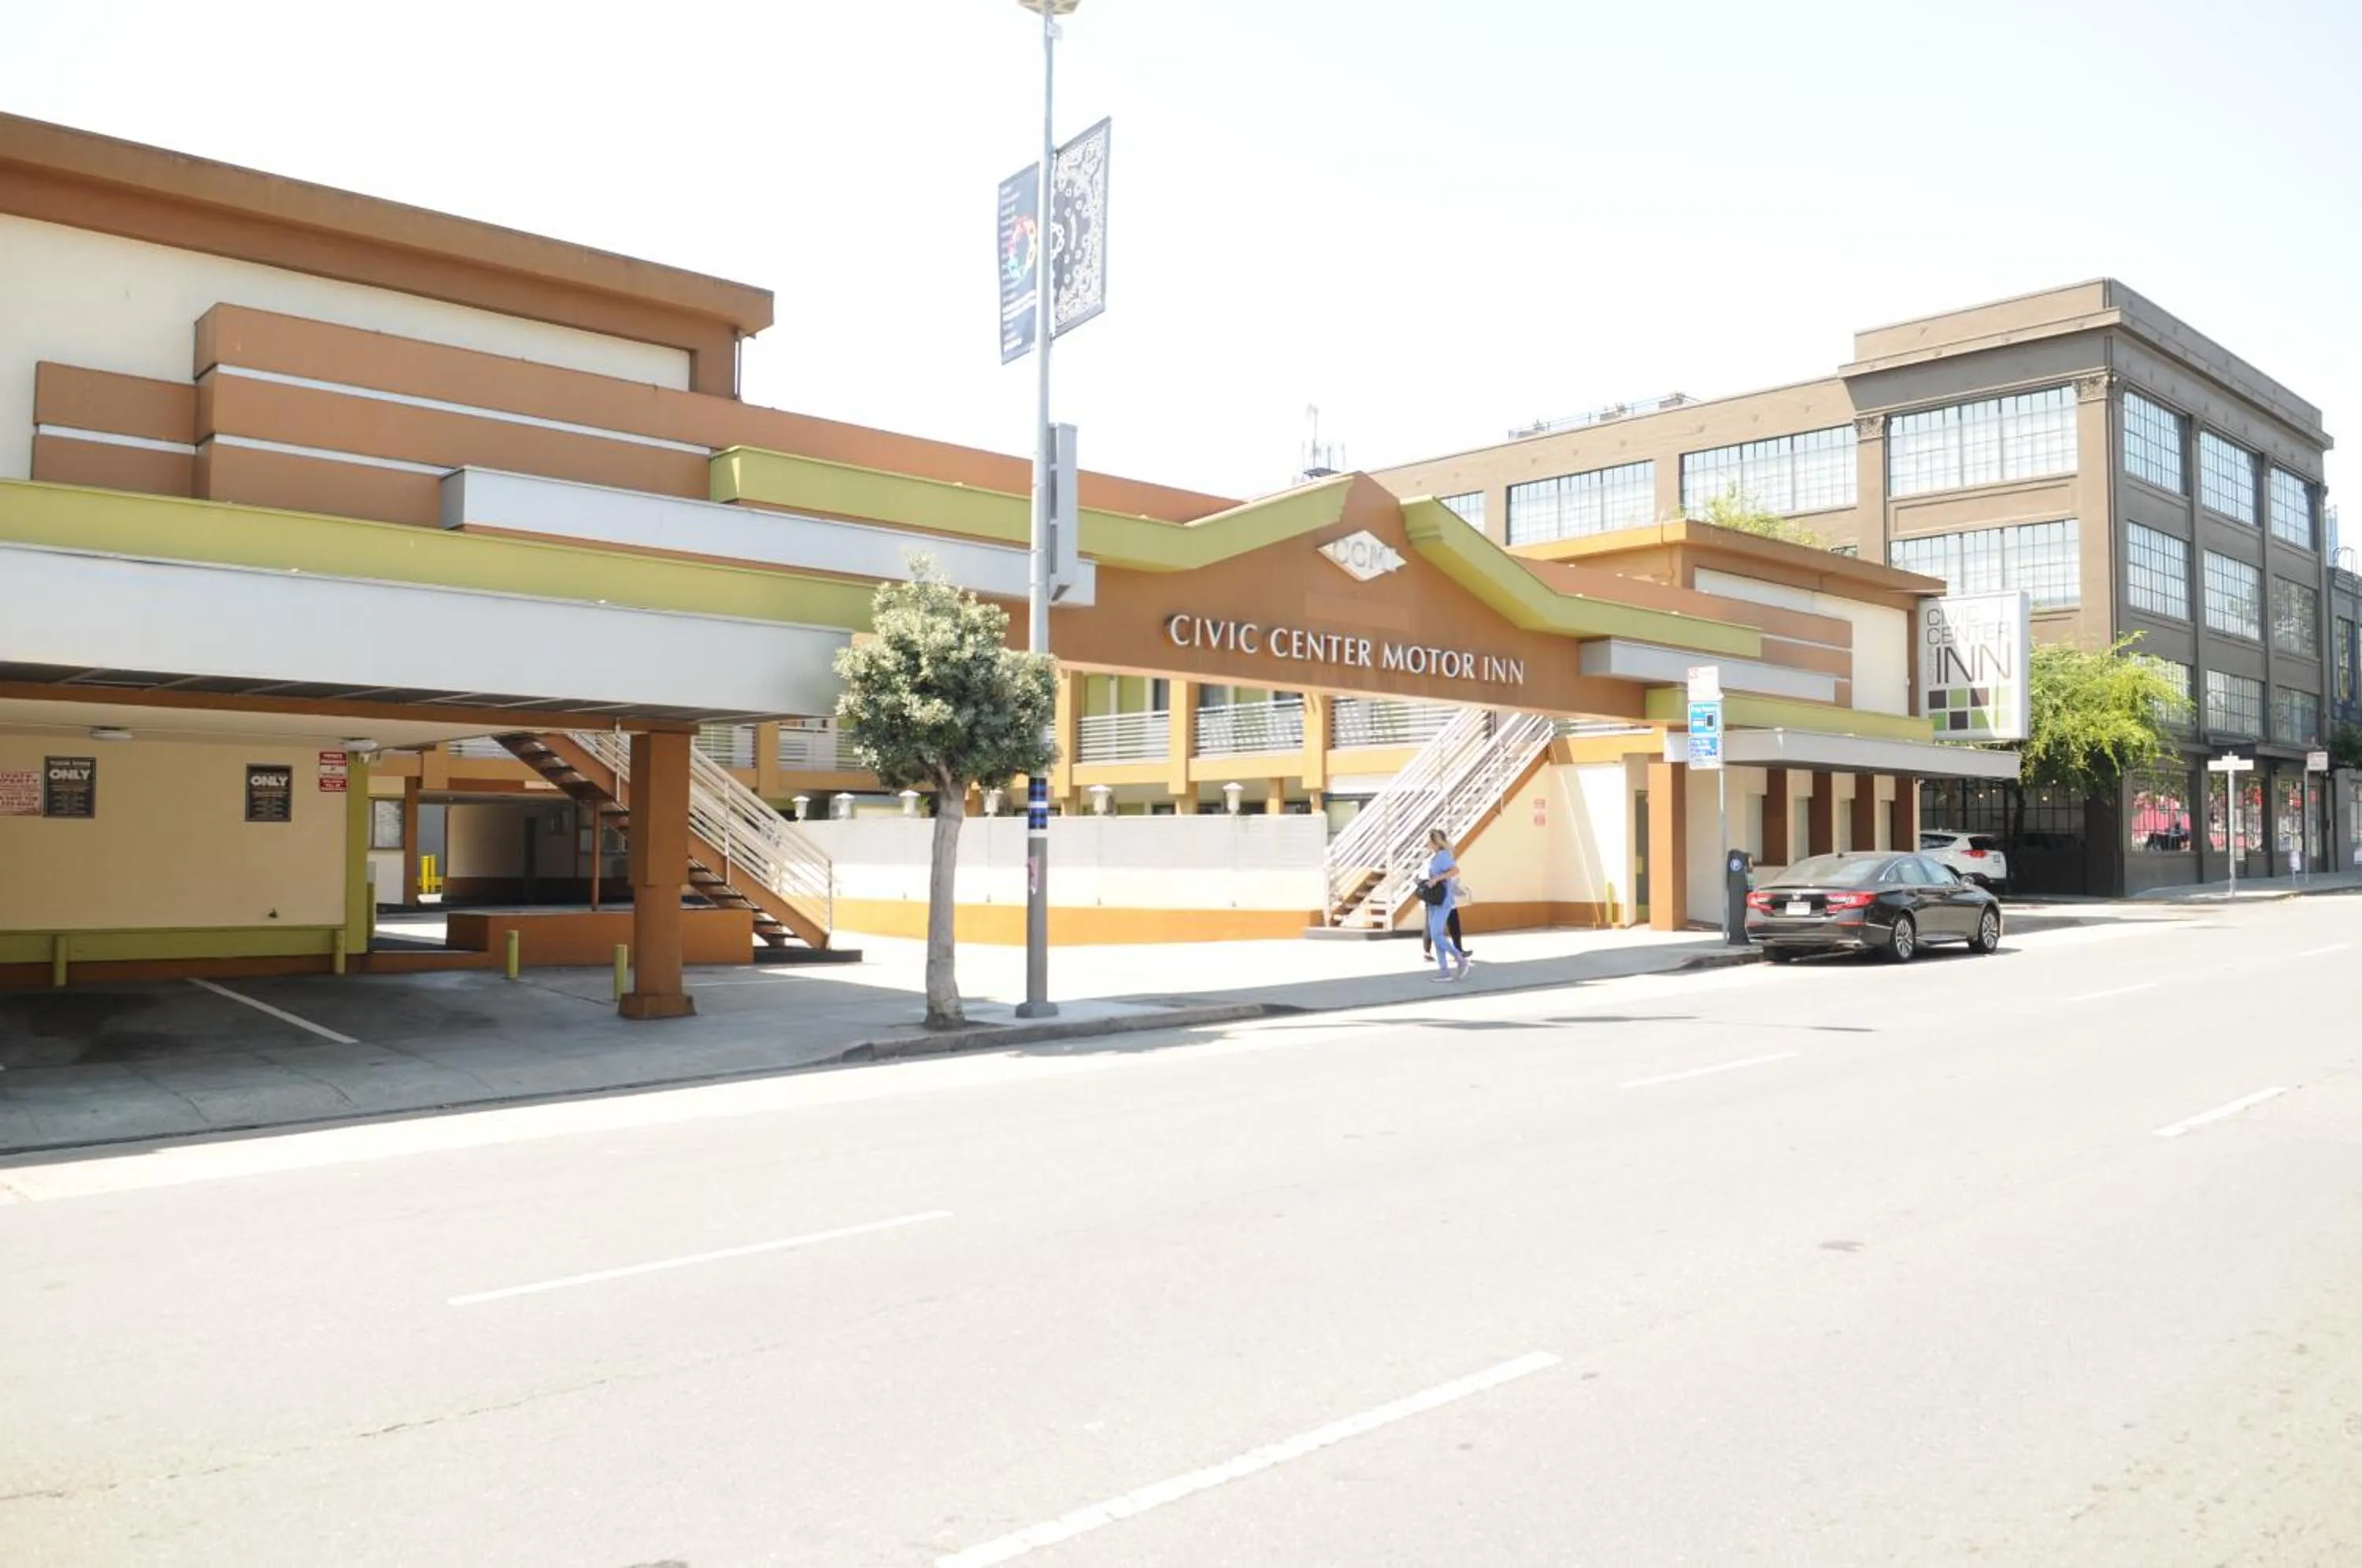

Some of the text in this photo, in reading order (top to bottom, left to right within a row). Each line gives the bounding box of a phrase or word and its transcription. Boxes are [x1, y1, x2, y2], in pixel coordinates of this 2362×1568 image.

[1927, 606, 1979, 626] CIVIC
[1927, 622, 2011, 645] CENTER
[1170, 614, 1525, 686] CIVIC CENTER MOTOR INN
[1936, 642, 2012, 683] INN
[50, 768, 91, 781] ONLY
[250, 775, 289, 787] ONLY
